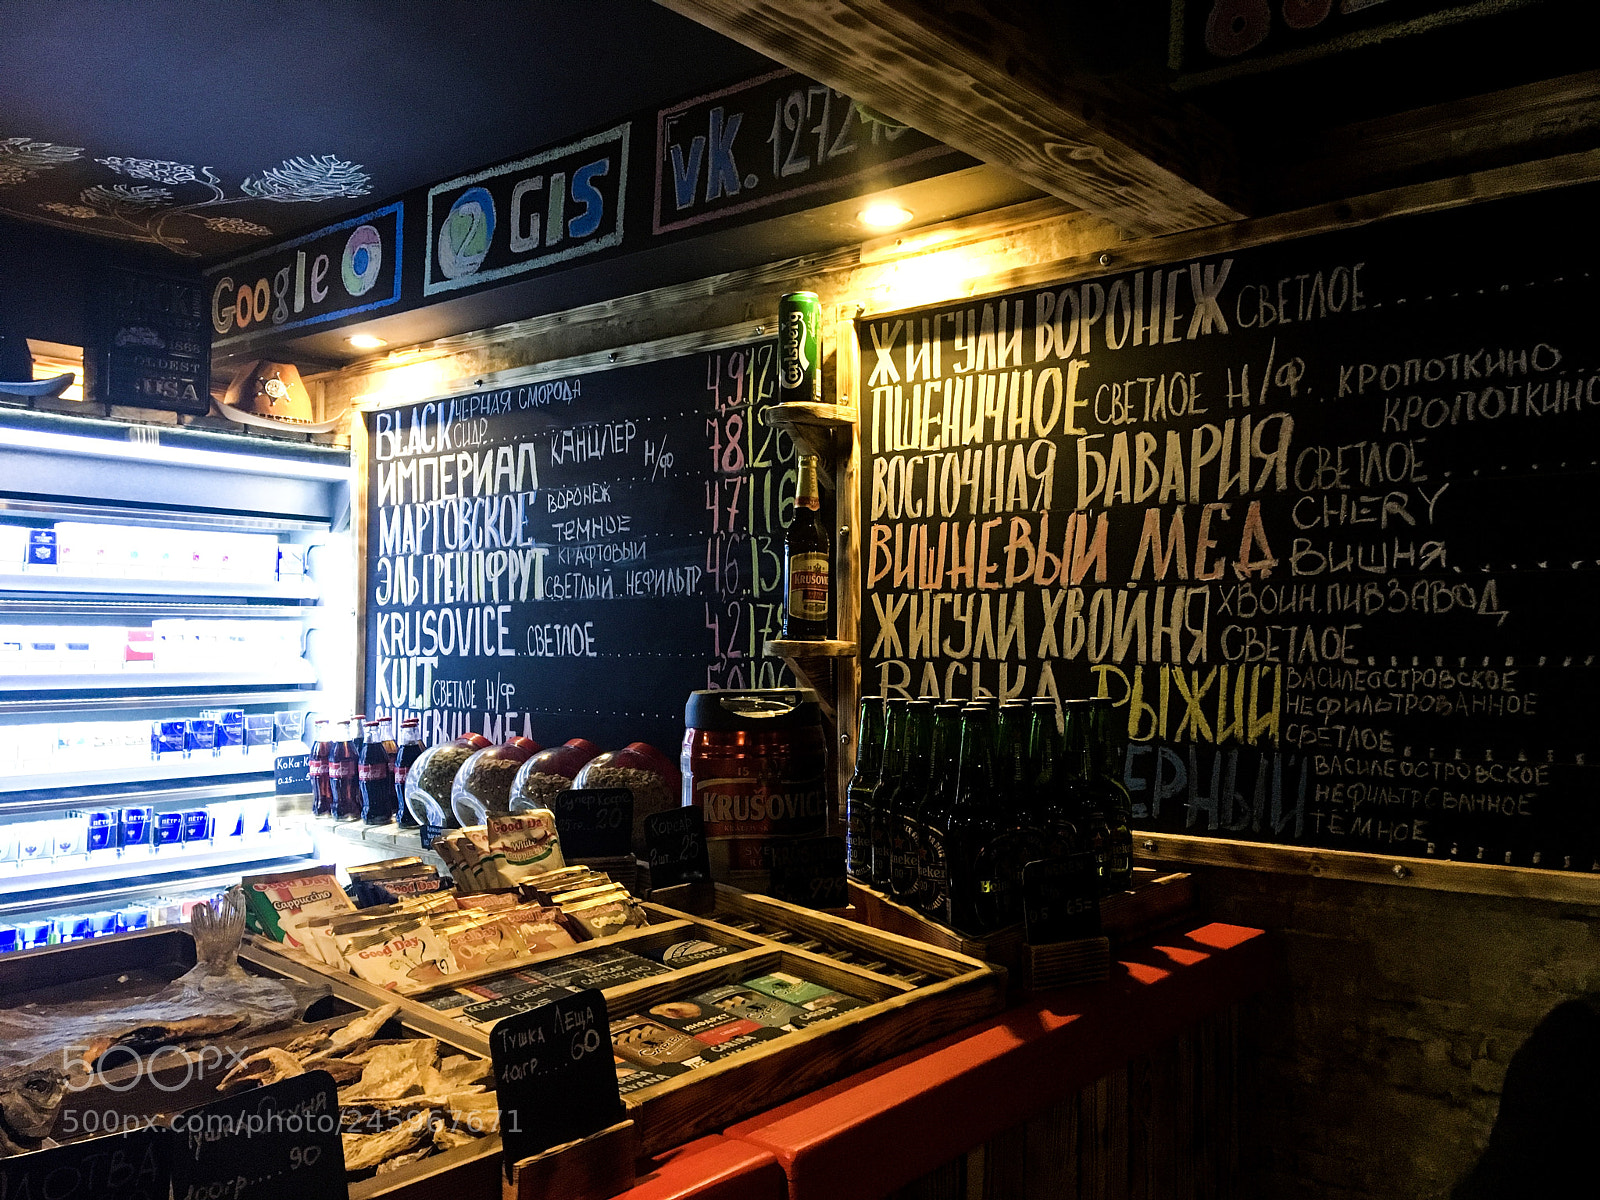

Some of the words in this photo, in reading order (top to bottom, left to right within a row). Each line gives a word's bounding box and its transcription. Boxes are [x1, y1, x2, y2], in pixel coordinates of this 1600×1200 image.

[510, 157, 610, 253] GIS
[212, 250, 329, 334] Google
[868, 299, 1024, 387] ЖИГУЛИ
[1035, 259, 1234, 362] ВОРОНЕЖ
[1236, 261, 1367, 328] СВЕТЛОЕ
[782, 310, 805, 389] Carlsberg
[143, 378, 200, 401] USA
[454, 389, 512, 422] ЧЕРНАЯ
[517, 378, 582, 410] СМОРОДА
[871, 358, 1091, 455] ПШЕНИЧНОЕ
[1094, 371, 1209, 425] СВЕТЛОЕ
[1338, 343, 1563, 399] КРОПОТКИНО
[375, 397, 456, 461] BLACK
[453, 417, 489, 448] СИДР
[377, 442, 539, 508] ИМПЕРИАЛ
[551, 422, 637, 468] КАНЦЛЕР
[870, 438, 1057, 522] ВОСТОЧНАЯ
[1076, 412, 1295, 510] БАВАРИЯ
[1294, 437, 1429, 492] СВЕТЛОЕ
[378, 491, 537, 557] МАРТОВСКОЕ
[547, 483, 612, 514] ВОРОНЕЖ
[1292, 482, 1450, 530] CHERY
[551, 515, 633, 543] ТЕМНОЕ
[1131, 501, 1279, 581] МЕД
[545, 568, 614, 600] СВЕТЛЫЙ
[375, 605, 517, 656] KRUSOVICE
[527, 622, 597, 657] СВЕТЛОЕ
[869, 589, 1027, 661] ЖИГУЛИ
[1037, 583, 1211, 665] ХВОЙНЯ
[1221, 623, 1363, 666] СВЕТЛОЕ
[375, 656, 439, 710] KULT
[432, 679, 477, 709] СВЕТЛОЕ
[1286, 667, 1519, 693] ВАСИЛЕОСТРОВСКОЕ
[1286, 691, 1539, 726] НЕФИЛЬТРОВАННОЕ
[1285, 723, 1394, 753] СВЕТЛОЕ
[1314, 754, 1551, 787] ВАСИЛЕОСТРОВСКОЕ
[1122, 742, 1309, 839] ЕРНЫЙ
[492, 820, 524, 833] Good
[527, 817, 550, 829] Day
[511, 837, 537, 851] White
[253, 880, 301, 893] Good
[300, 875, 332, 888] Day
[272, 890, 333, 912] Cappuccino
[385, 882, 415, 894] Good
[416, 878, 441, 891] Day
[358, 943, 393, 960] Good
[392, 935, 421, 953] Day
[450, 931, 475, 945] ood
[473, 925, 498, 940] Day
[682, 1011, 731, 1032] ИНФАРКТ
[570, 1028, 601, 1061] 60
